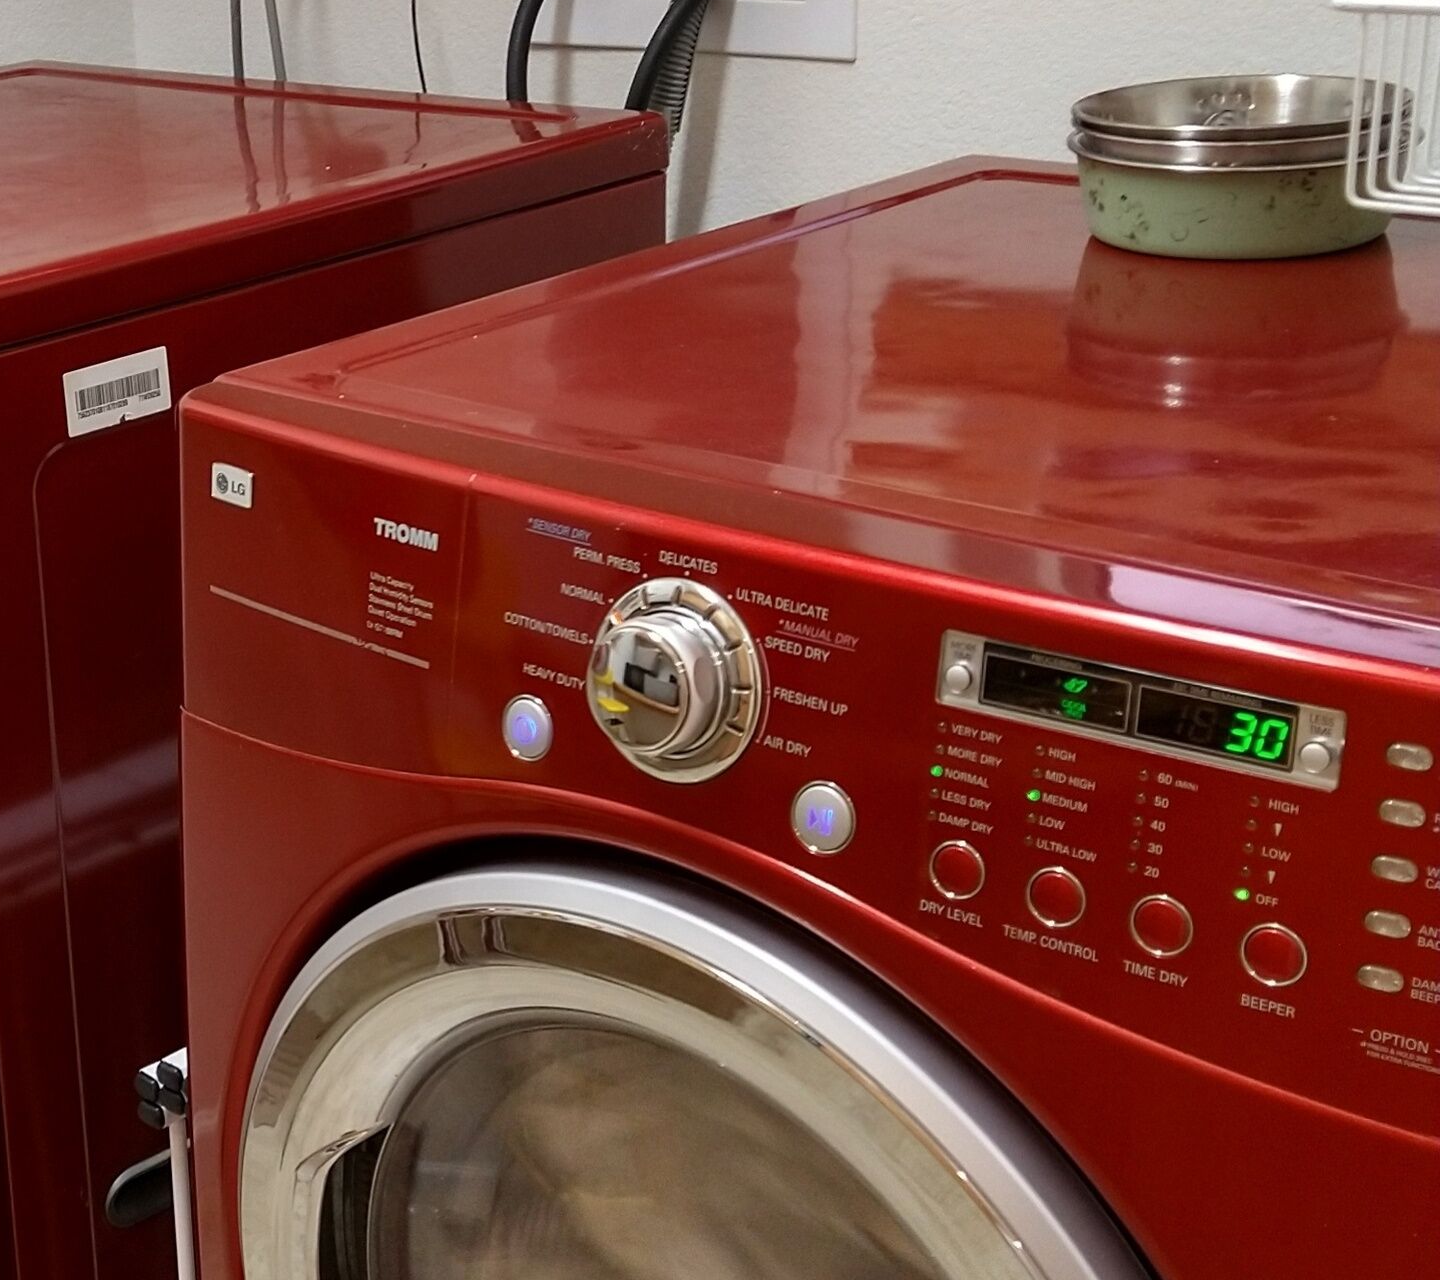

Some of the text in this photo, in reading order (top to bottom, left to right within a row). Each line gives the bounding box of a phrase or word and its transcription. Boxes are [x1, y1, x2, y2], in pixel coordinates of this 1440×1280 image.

[231, 480, 246, 496] LG
[374, 517, 439, 552] TROMM
[571, 527, 592, 542] DRY
[607, 554, 641, 574] PRESS
[659, 550, 718, 575] DELICATES
[559, 583, 605, 605] NORMAL
[736, 587, 829, 622] ULTRA DELICATE
[504, 611, 588, 645] COTTON/TOWELS
[784, 620, 859, 648] MANUAL DRY
[764, 636, 830, 663] SPEED DRY
[523, 663, 586, 691] HEAVY DUTY
[773, 686, 848, 717] FRESHEN UP
[951, 723, 1003, 745] VERY DRY
[1224, 712, 1289, 760] 30
[763, 735, 811, 758] AIR DRY
[947, 745, 1003, 768] MORE DRY
[1048, 747, 1077, 763] HIGH
[944, 767, 990, 789] NORMAL
[1045, 770, 1097, 792] MID HIGH
[1157, 772, 1173, 786] 60
[941, 789, 992, 811] LESS DRY
[1042, 792, 1088, 813] MEDIUM
[1153, 795, 1170, 809] 50
[1268, 798, 1300, 816] HIGH
[938, 812, 994, 836] DAMP DRY
[1039, 815, 1066, 831] LOW
[1150, 819, 1166, 833] 40
[1036, 837, 1097, 863] ULTRA LOW
[1147, 842, 1163, 855] 30
[1262, 845, 1291, 862] LOW
[1143, 865, 1160, 879] 20
[1255, 893, 1279, 908] OFF
[919, 898, 984, 928] DRY LEVEL
[1002, 924, 1100, 963] TEMP. CONTROL
[1122, 959, 1189, 988] TIME DRY
[1240, 993, 1296, 1019] BEEPER
[1370, 1028, 1429, 1055] OPTION
